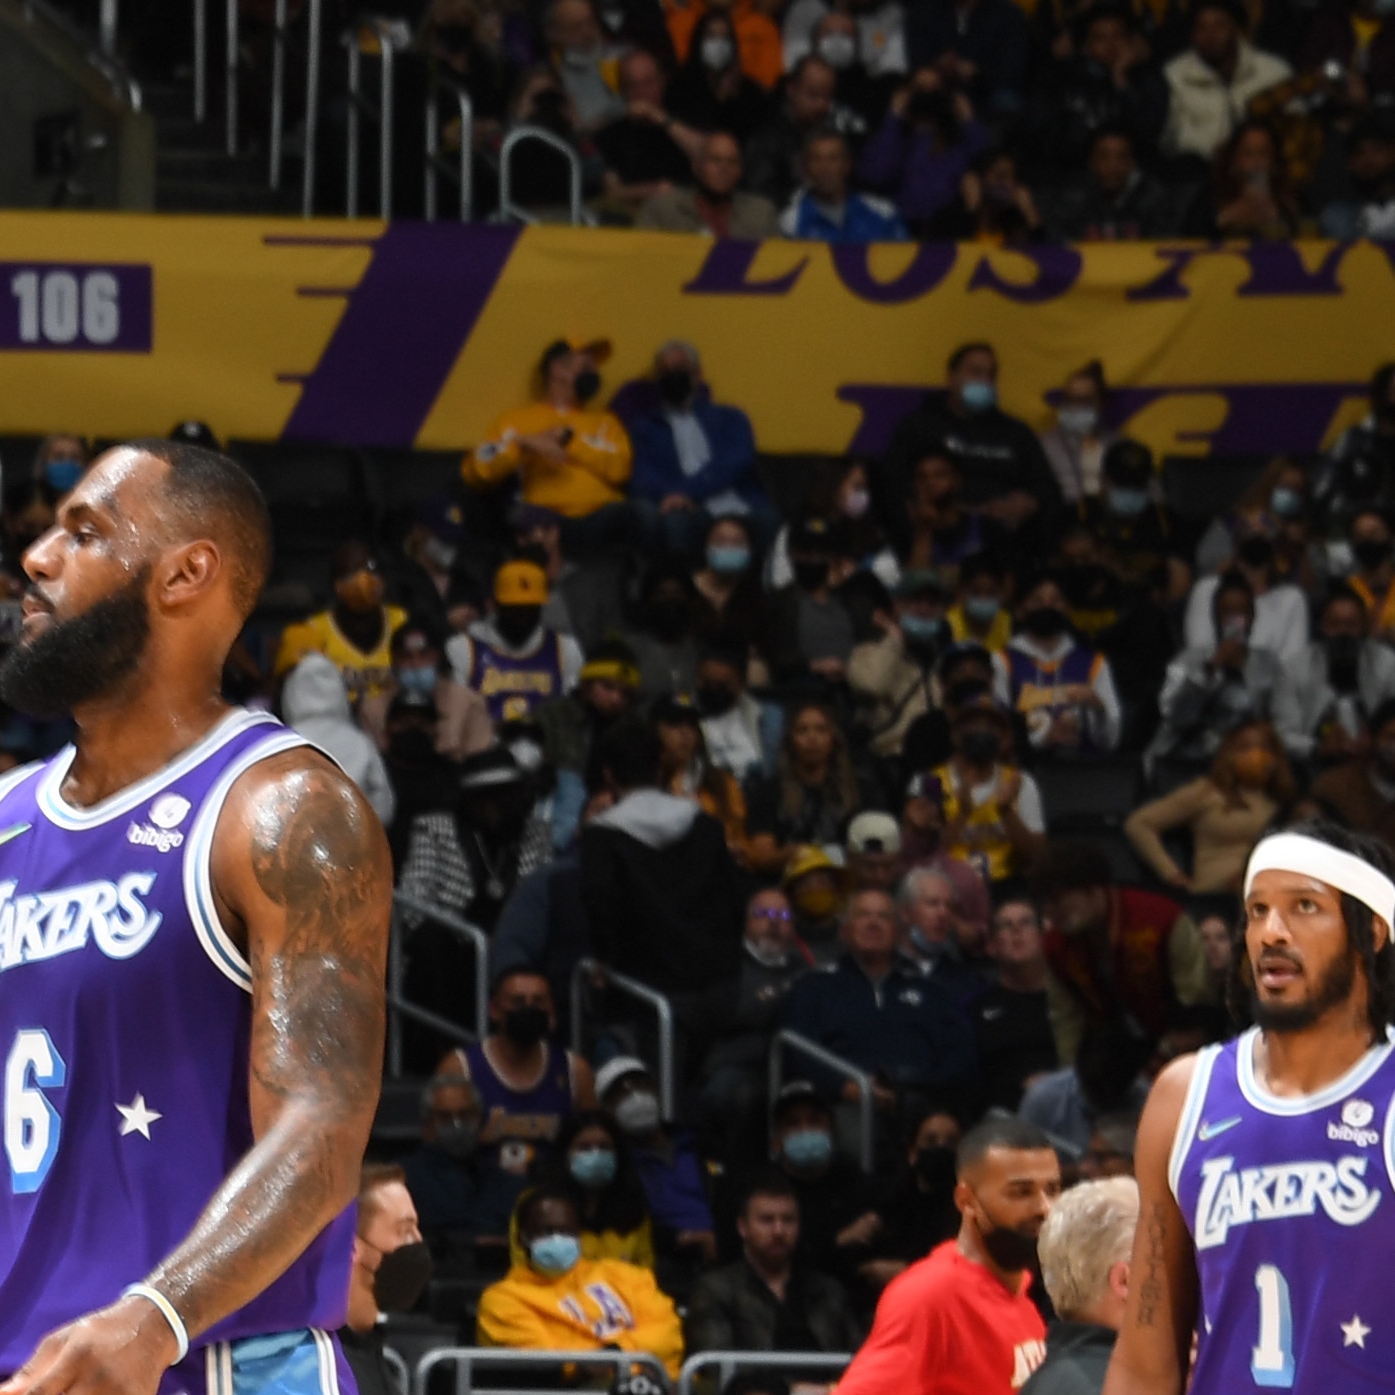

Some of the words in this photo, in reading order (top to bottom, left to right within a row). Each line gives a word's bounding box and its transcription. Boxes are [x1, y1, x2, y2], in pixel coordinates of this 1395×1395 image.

[12, 271, 119, 344] 106
[127, 821, 184, 853] bibigo
[5, 1026, 67, 1194] 6
[1328, 1120, 1378, 1147] bibigo
[1195, 1155, 1381, 1251] LAKERS
[1251, 1264, 1295, 1388] 1
